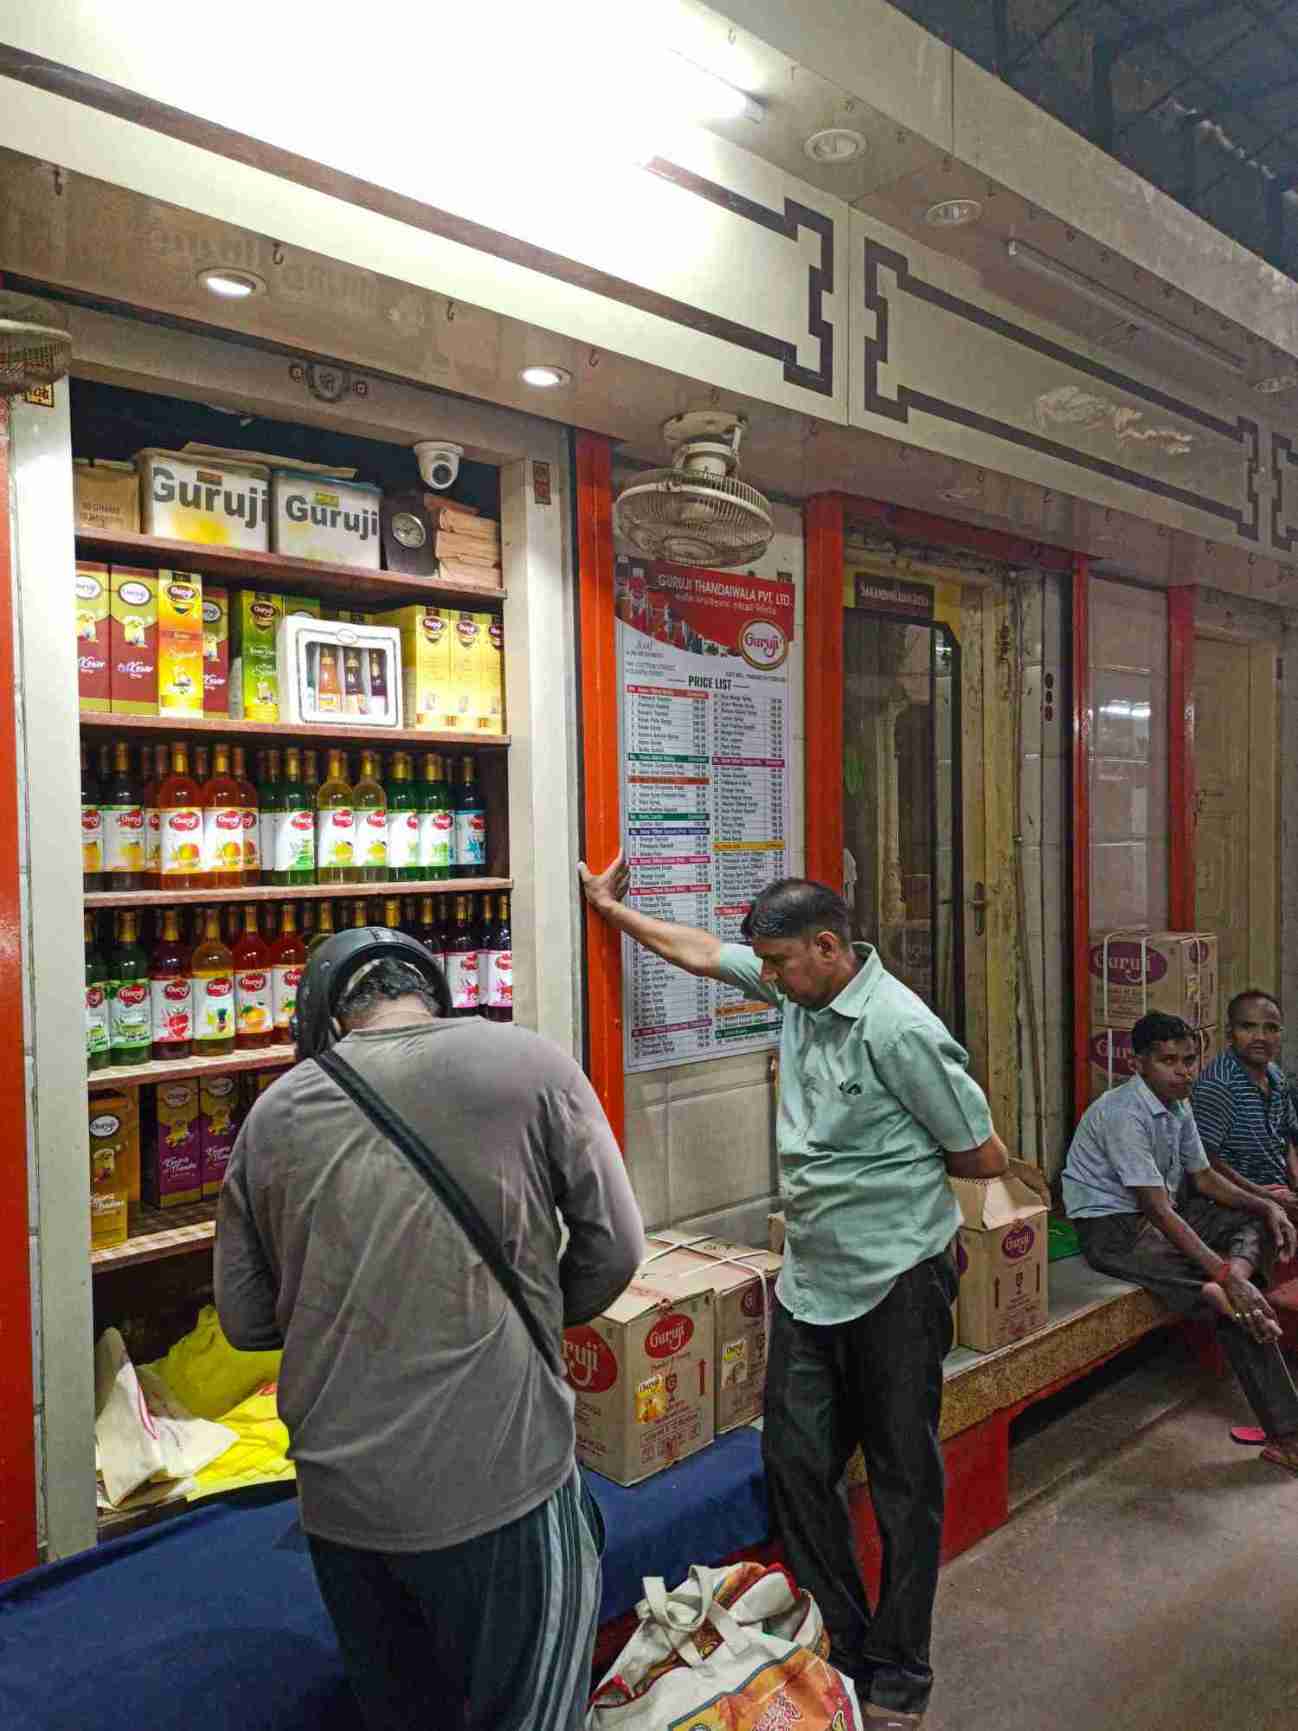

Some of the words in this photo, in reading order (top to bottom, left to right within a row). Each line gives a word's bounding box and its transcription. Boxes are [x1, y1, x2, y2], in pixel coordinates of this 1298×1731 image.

[152, 466, 268, 529] Guruji
[286, 494, 378, 541] Guruji
[688, 674, 712, 690] PRICE
[715, 677, 733, 691] LIST
[650, 1323, 686, 1350] Guruji
